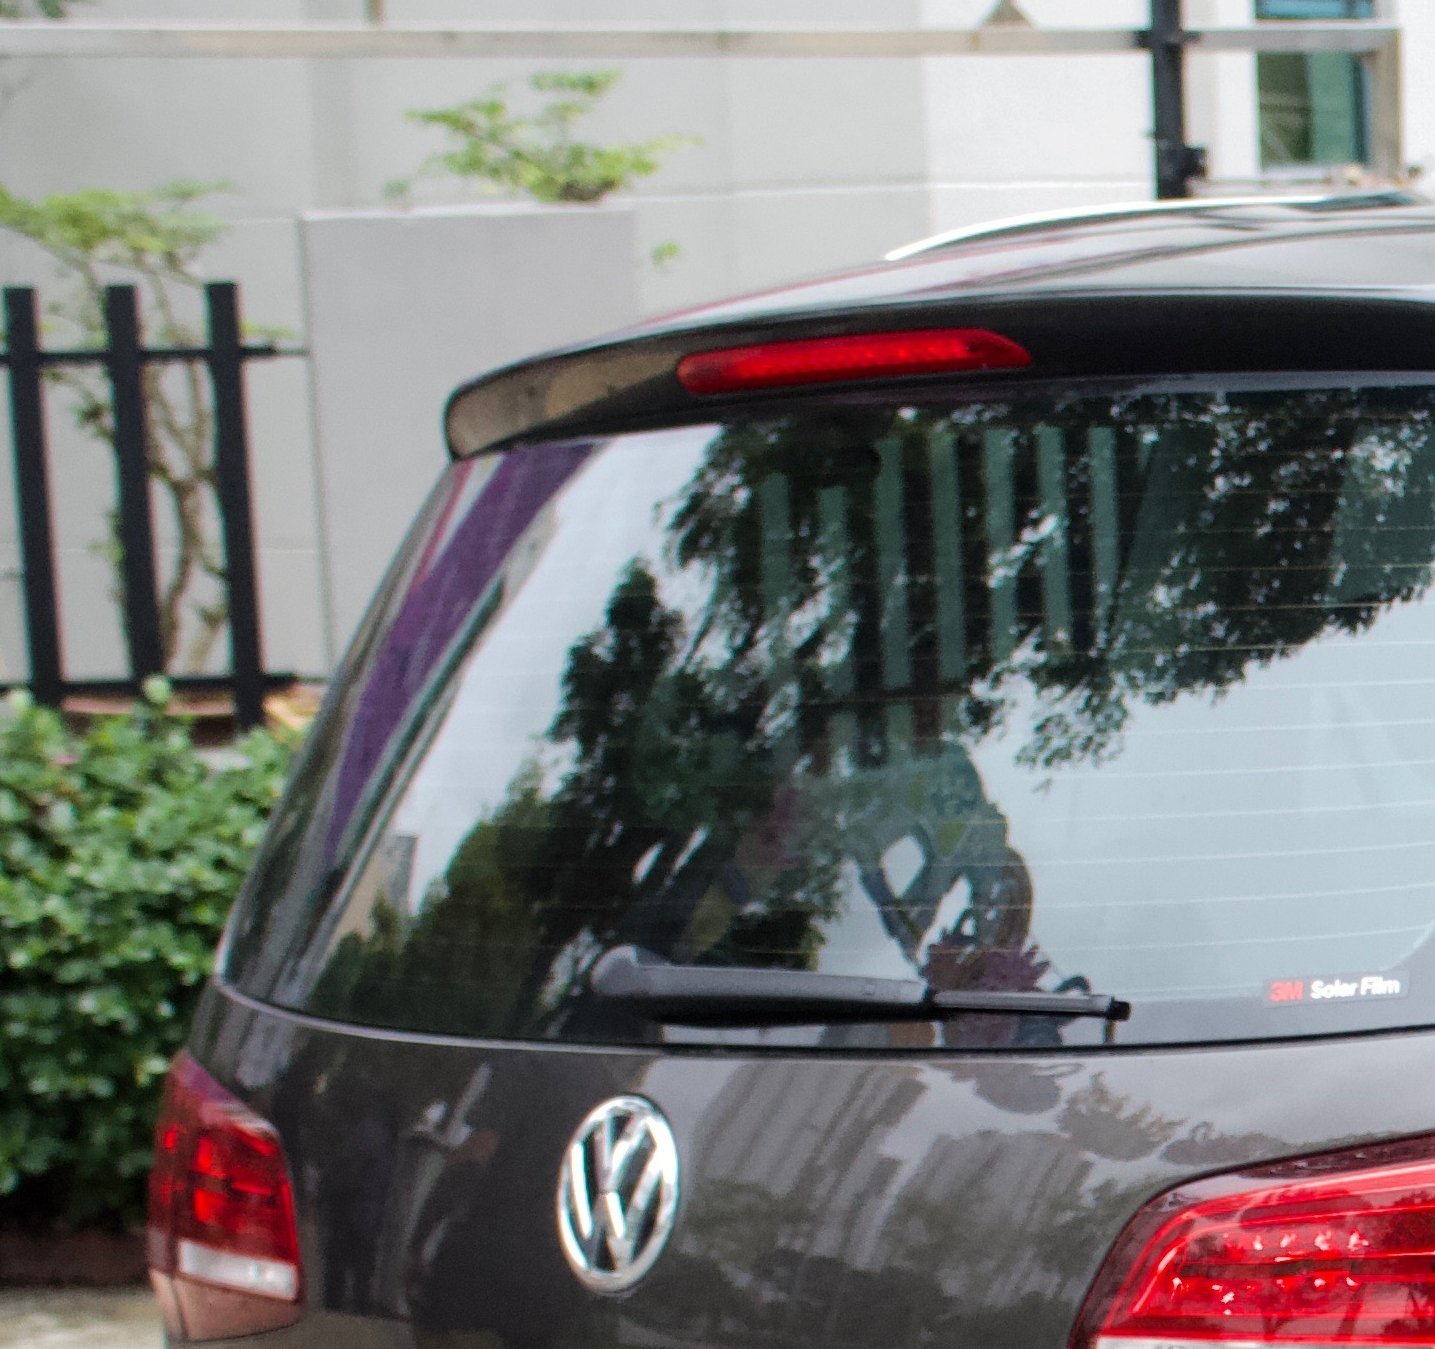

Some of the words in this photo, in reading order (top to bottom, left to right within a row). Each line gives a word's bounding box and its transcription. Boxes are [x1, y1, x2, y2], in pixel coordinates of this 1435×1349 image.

[1270, 979, 1304, 1002] 3M
[1310, 978, 1358, 999] Solar
[1360, 975, 1401, 996] Film
